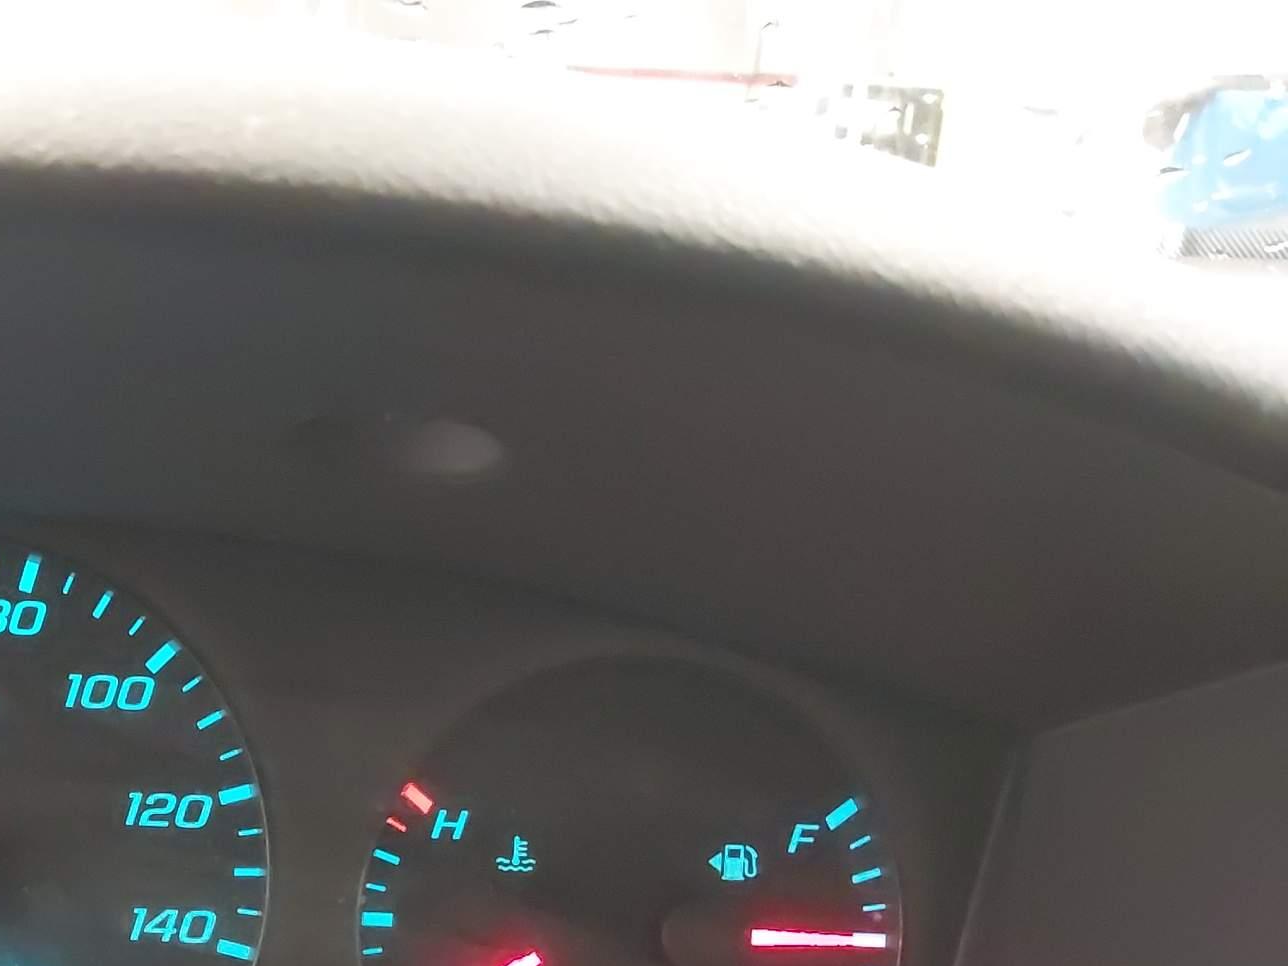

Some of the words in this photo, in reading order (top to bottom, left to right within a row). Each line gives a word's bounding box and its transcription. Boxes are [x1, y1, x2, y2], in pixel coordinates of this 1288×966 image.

[63, 673, 155, 712] 100
[124, 792, 213, 830] 120
[431, 809, 468, 839] H
[787, 823, 819, 853] F
[129, 907, 217, 944] 140
